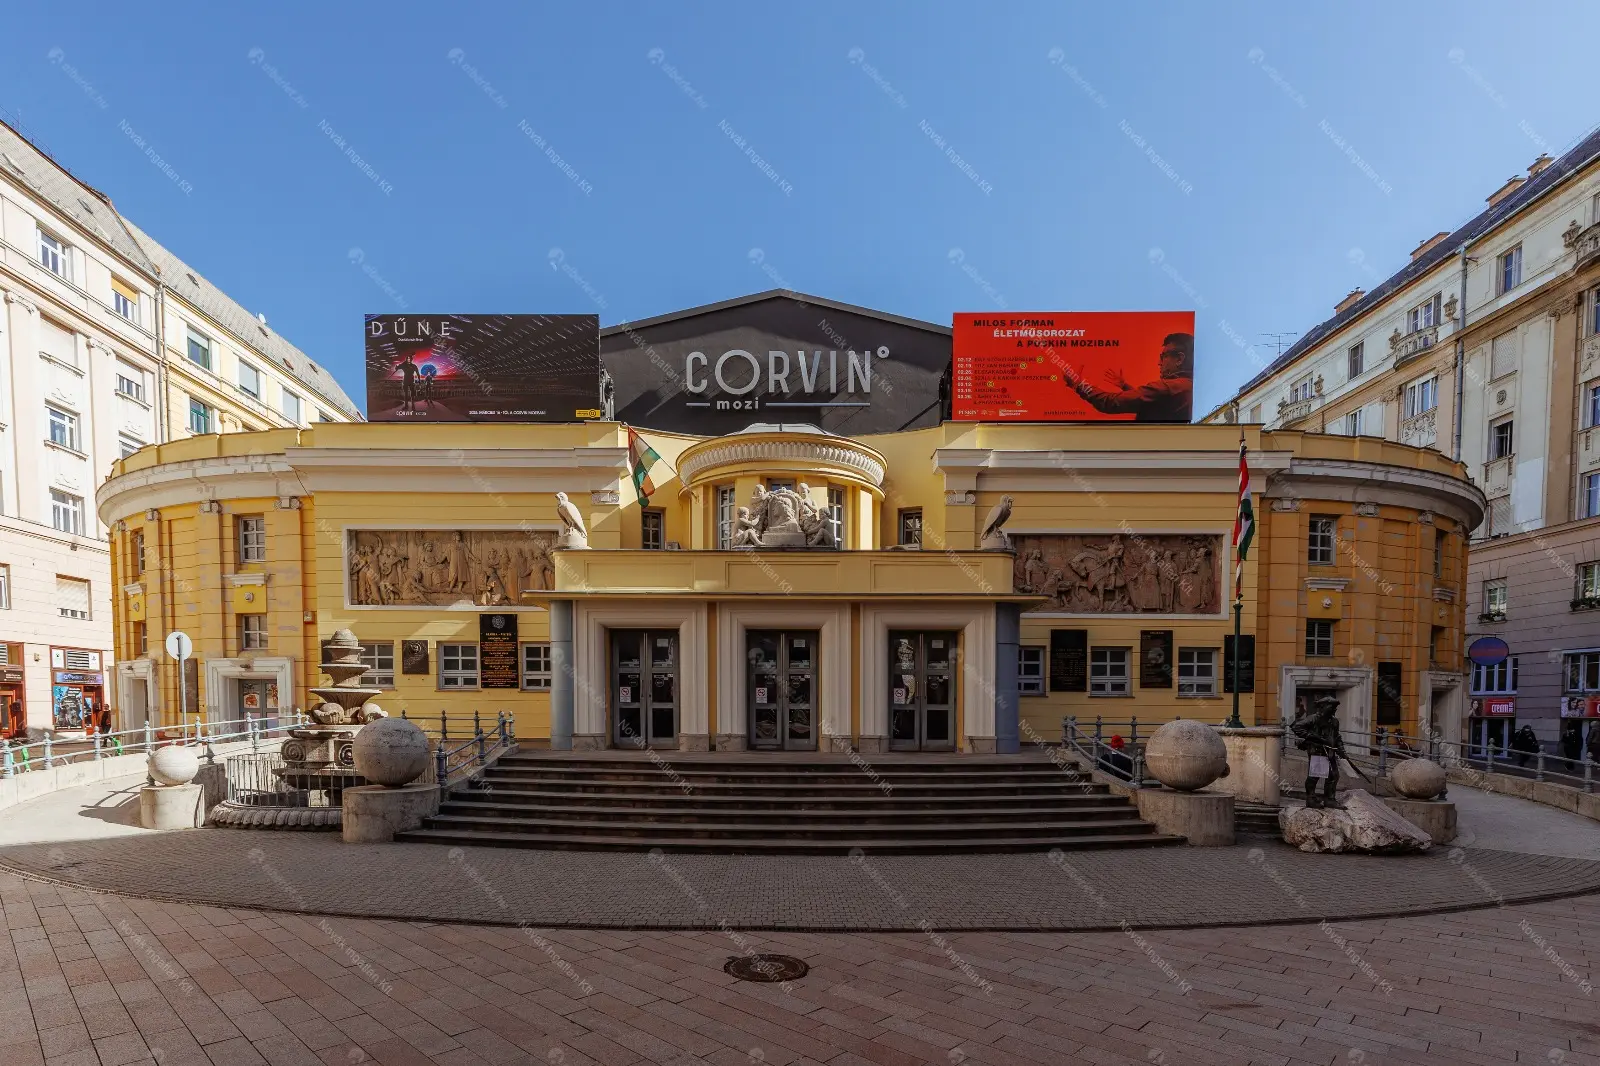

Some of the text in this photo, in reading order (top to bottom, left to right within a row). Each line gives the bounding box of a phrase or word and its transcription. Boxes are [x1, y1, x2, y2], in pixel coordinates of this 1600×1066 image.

[371, 317, 450, 336] DŰNE
[973, 319, 1054, 327] MILOS FORMAN
[993, 327, 1086, 338] ÉLETMŰSOROZAT
[1070, 339, 1119, 347] MOZIBAN
[716, 397, 759, 410] mozi
